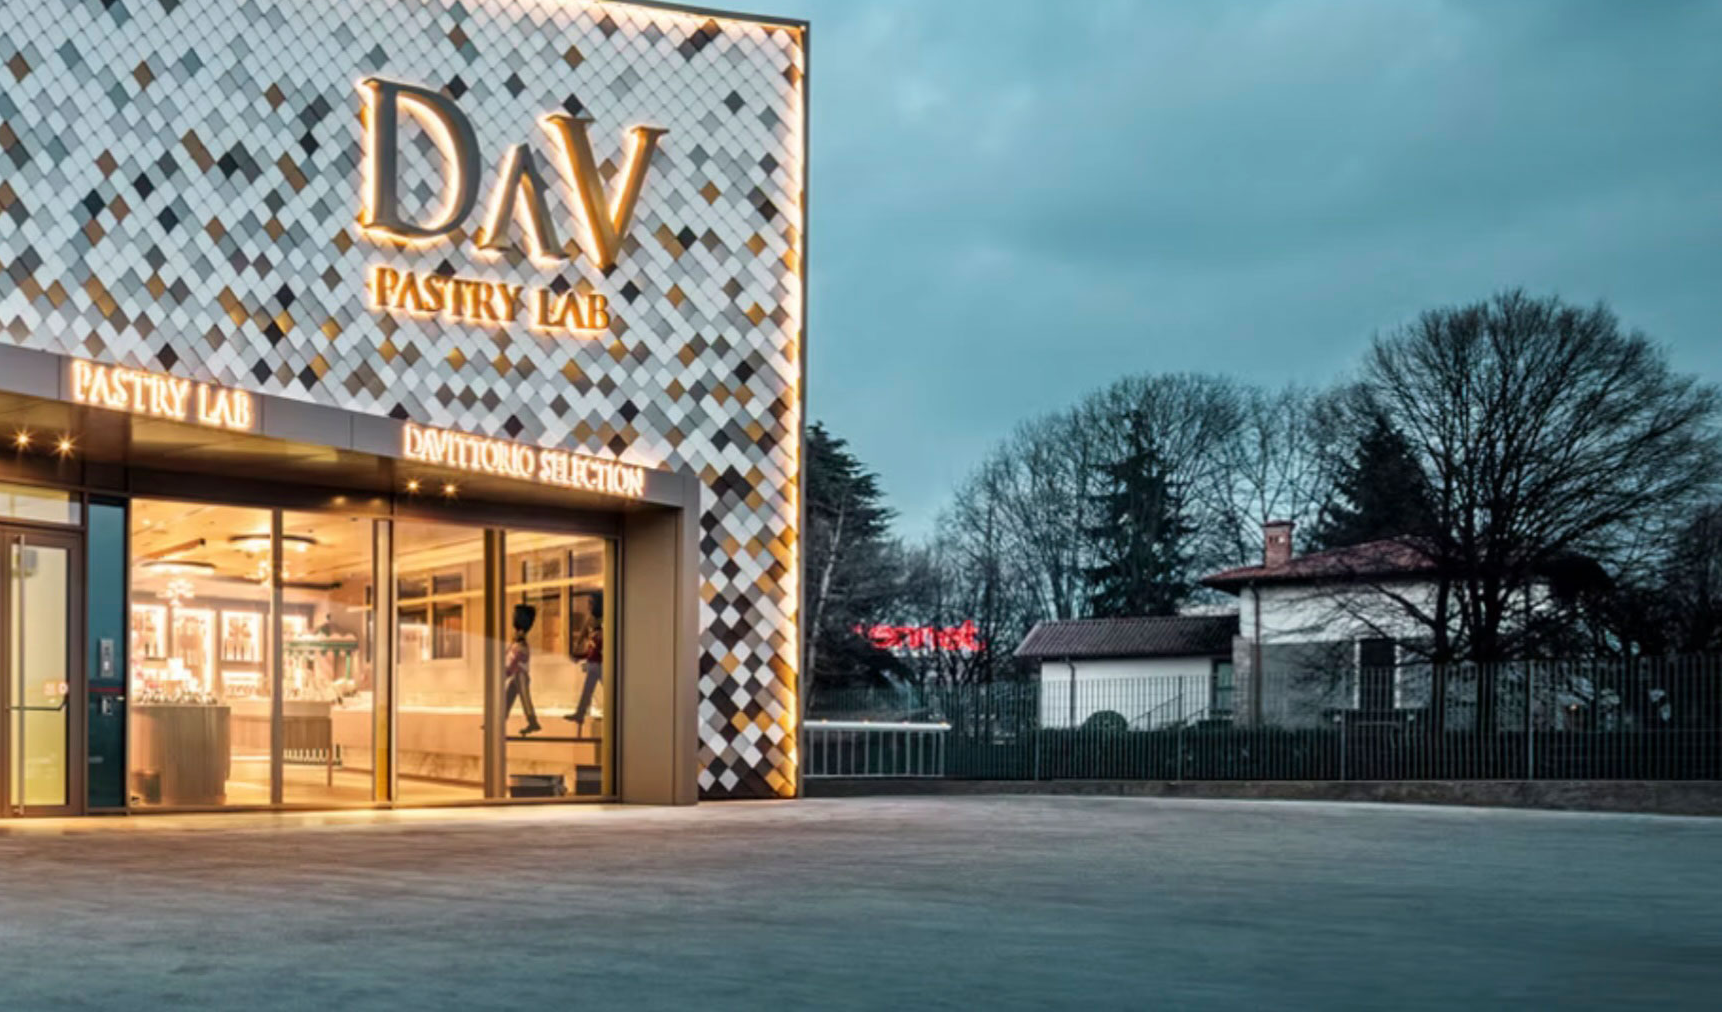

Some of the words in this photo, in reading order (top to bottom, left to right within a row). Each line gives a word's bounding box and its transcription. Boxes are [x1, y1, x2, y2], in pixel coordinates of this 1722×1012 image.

[373, 267, 523, 323] PASTRY
[535, 289, 610, 330] LAB
[72, 360, 190, 419] PASTRY
[198, 385, 251, 429] LAB
[539, 449, 644, 496] SELECTION
